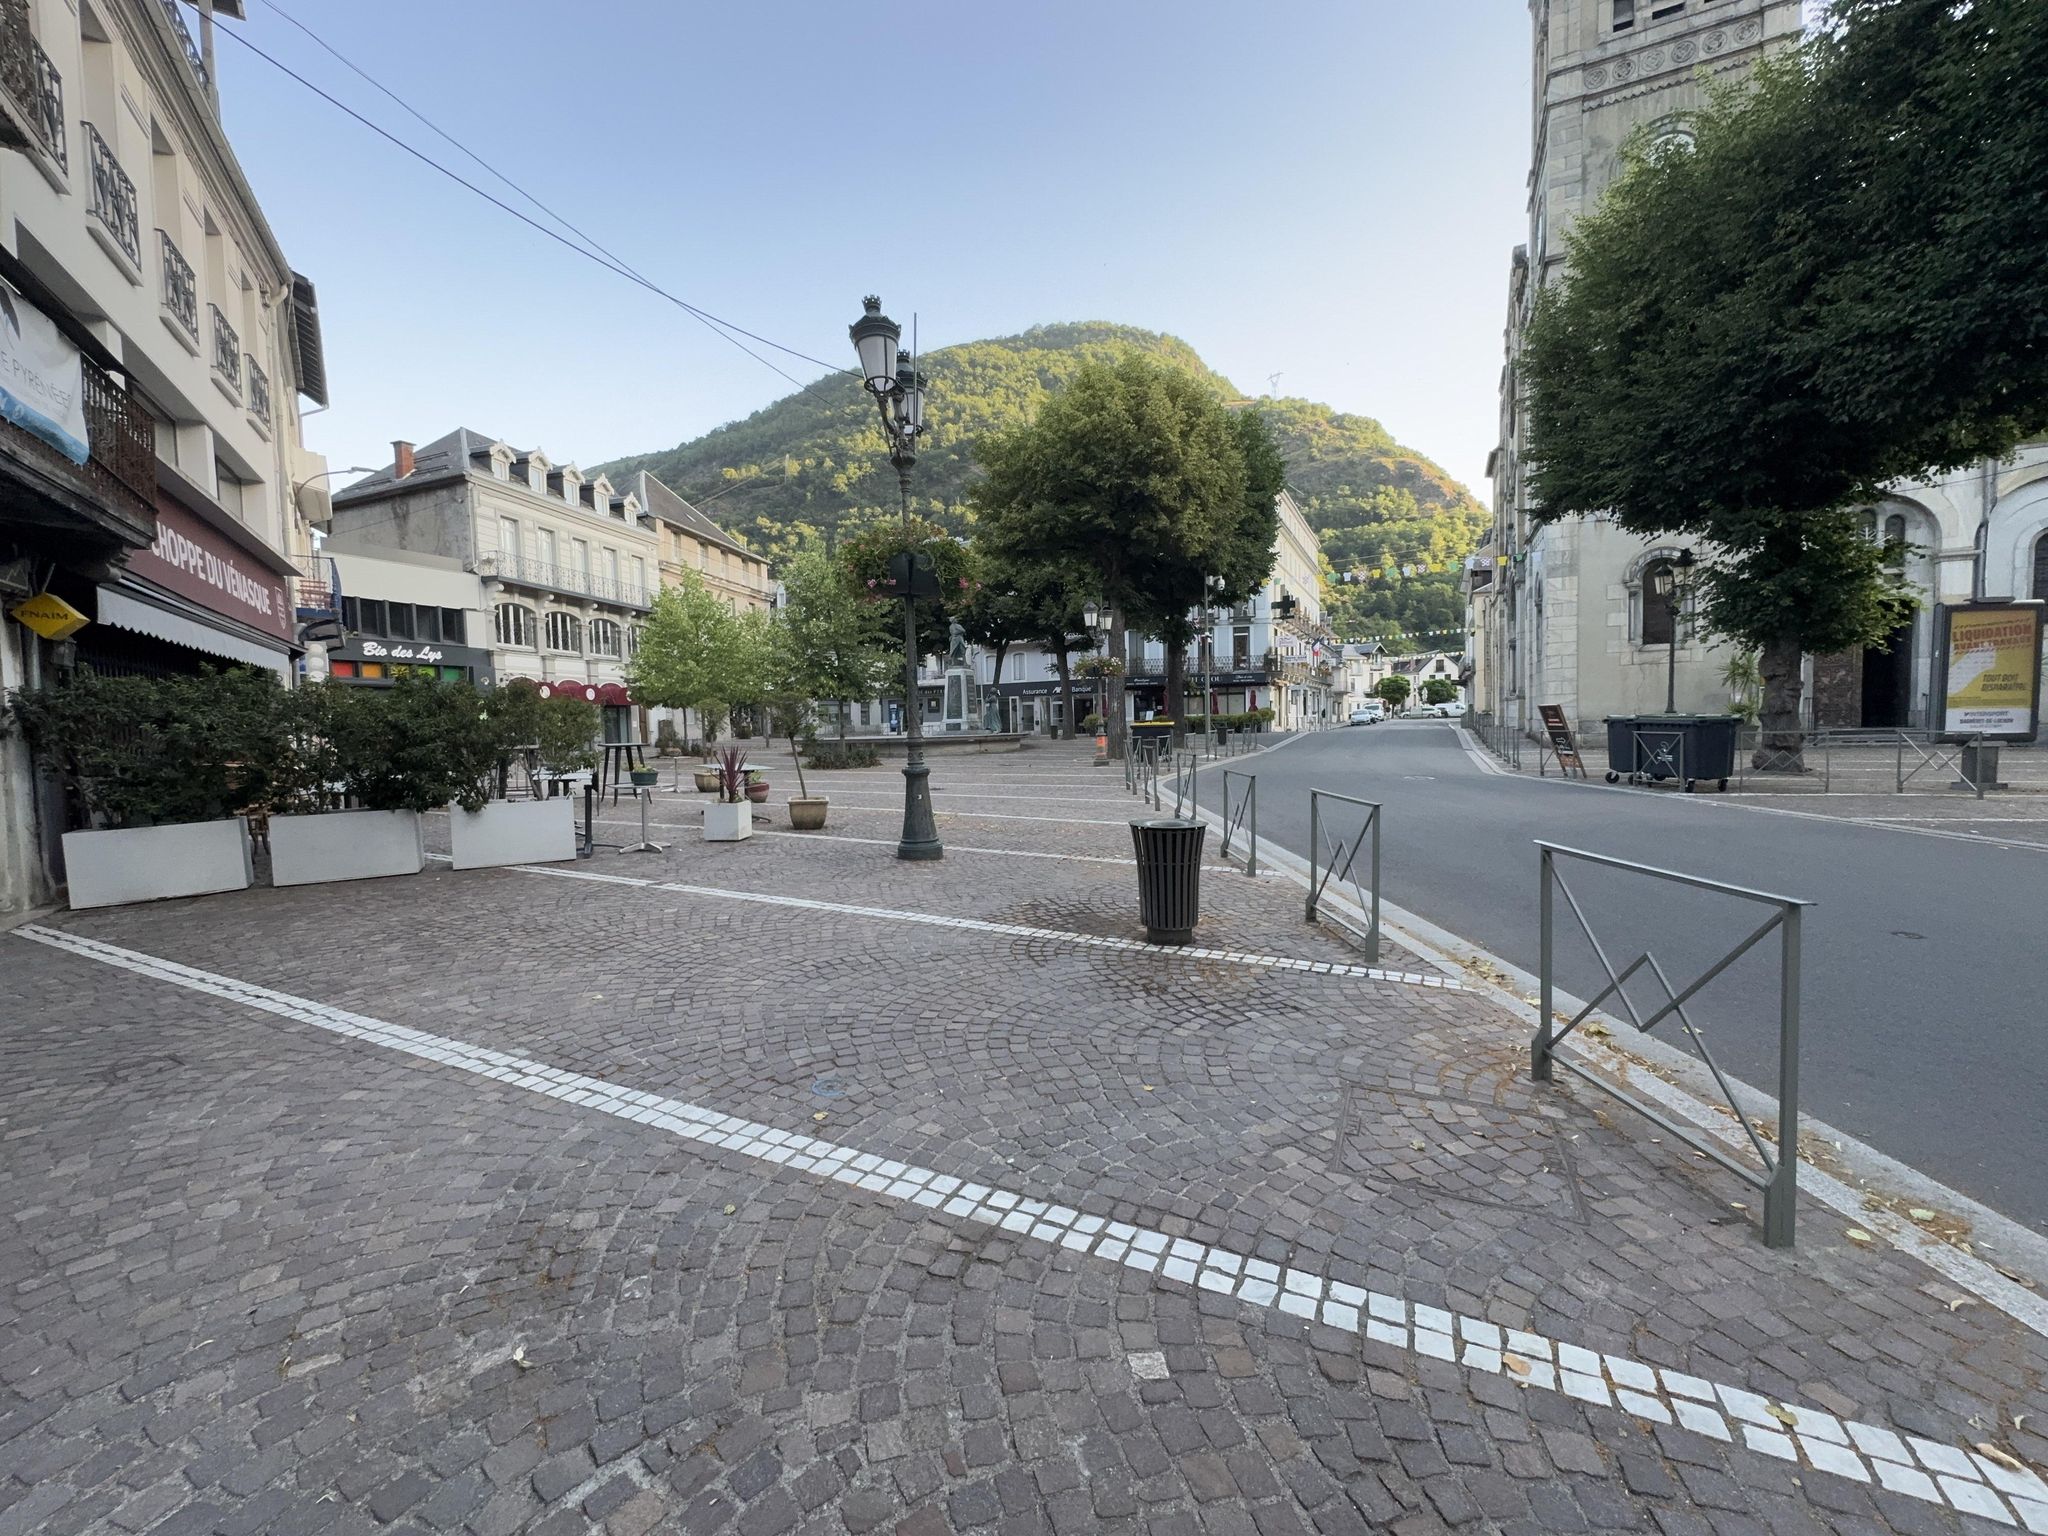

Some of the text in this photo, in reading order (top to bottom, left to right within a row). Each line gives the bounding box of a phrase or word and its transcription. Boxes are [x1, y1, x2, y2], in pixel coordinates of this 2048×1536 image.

[204, 551, 223, 590] DU
[222, 559, 272, 615] VÉNASQUE
[21, 610, 69, 621] FNAIM
[1952, 623, 2032, 642] LIQUIDATION
[362, 641, 443, 663] Bio des Lys
[1071, 686, 1092, 694] Banque
